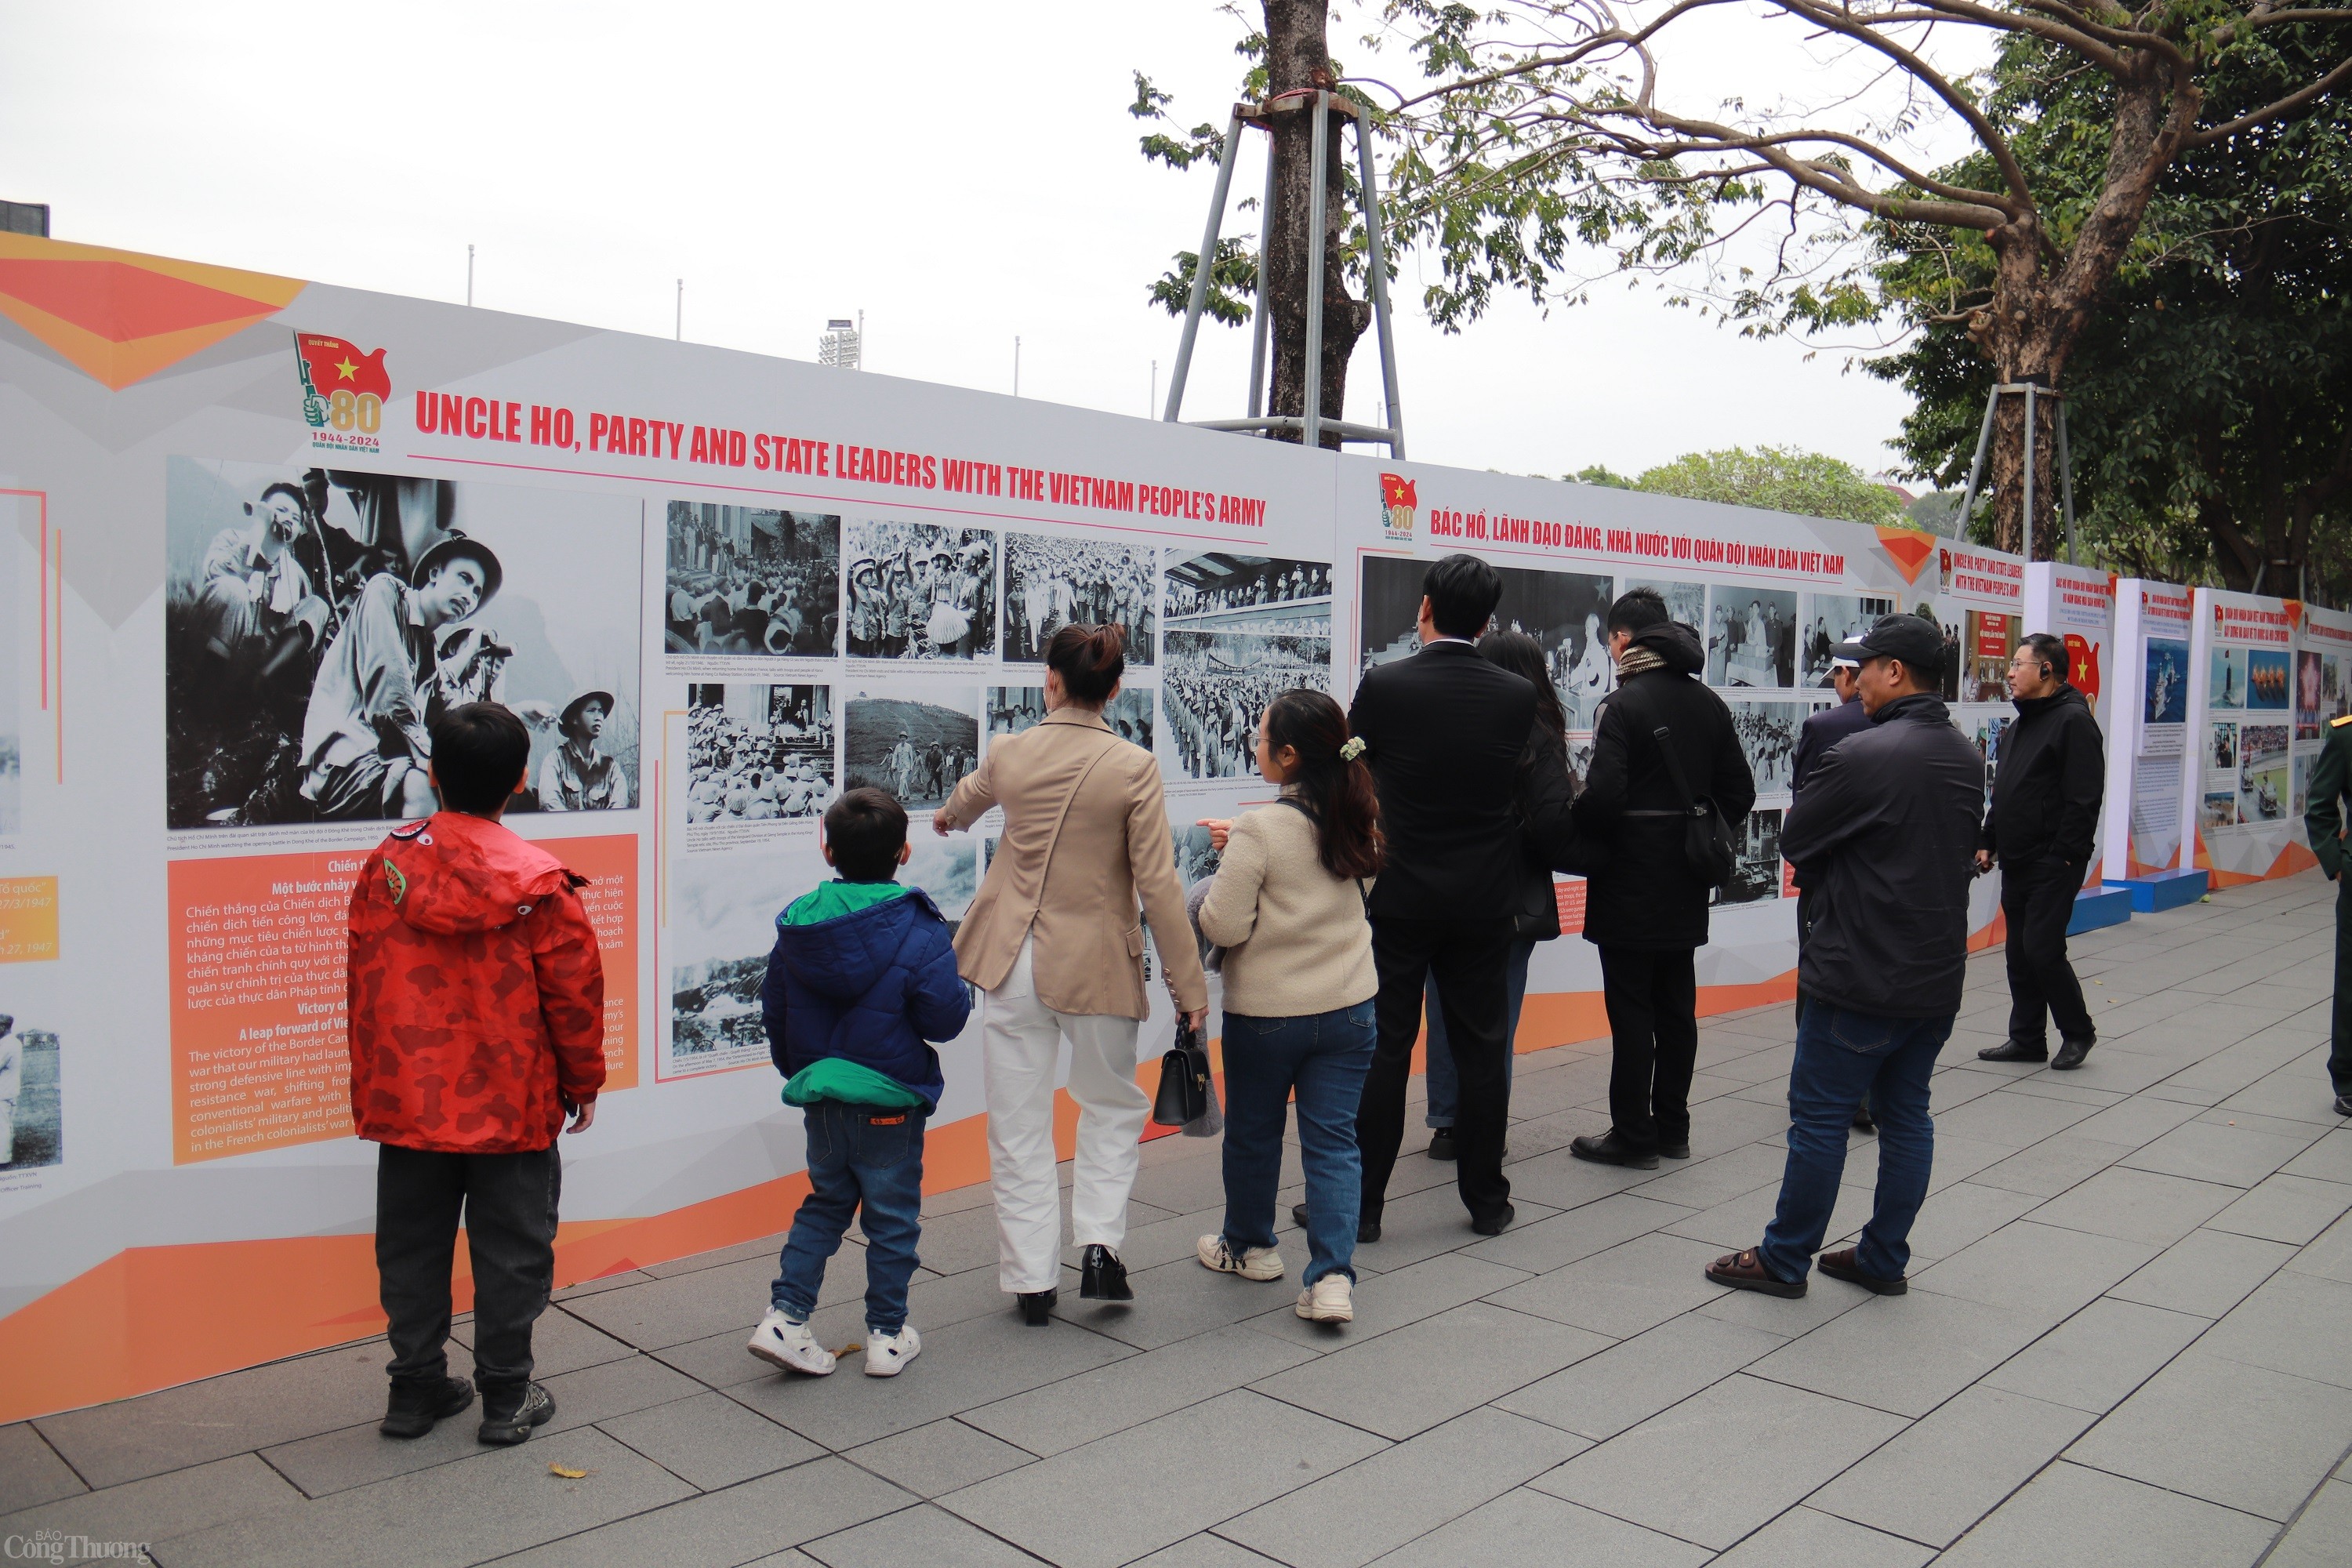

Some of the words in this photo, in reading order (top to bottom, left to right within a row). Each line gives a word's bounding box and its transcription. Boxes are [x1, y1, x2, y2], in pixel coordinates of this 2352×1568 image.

[331, 391, 381, 434] 80
[312, 432, 379, 447] 1944-2024
[416, 391, 521, 442] UNCLE
[530, 405, 581, 454] HO,
[590, 412, 685, 460] PARTY
[689, 426, 746, 467] AND
[753, 433, 829, 477] STATE
[836, 445, 936, 490] LEADERS
[942, 458, 1000, 497] WITH
[1007, 466, 1044, 503] THE
[1049, 472, 1133, 512] VIETNAM
[1219, 495, 1266, 528] ARMY
[1392, 505, 1413, 530] 80
[1431, 506, 1461, 536] BÁC
[1466, 508, 1489, 542] HỒ,
[1493, 514, 1529, 543] LÃNH
[1533, 521, 1561, 549] ĐẠO
[1565, 521, 1603, 553] ĐẢNG,
[1606, 527, 1632, 554] NHÀ
[1636, 531, 1668, 557] NƯỚC
[1671, 534, 1691, 559] VỚI
[1694, 539, 1723, 563] QUÂN
[1726, 541, 1744, 568] ĐỘI
[1748, 544, 1775, 568] NHÂN
[1778, 548, 1797, 570] DÂN
[1801, 550, 1820, 575] VIỆT
[1824, 556, 1843, 575] NAM
[328, 859, 357, 873] Chiến
[272, 883, 292, 897] Một
[296, 880, 321, 895] bước
[324, 880, 349, 893] nhảy
[606, 875, 623, 885] một
[582, 890, 601, 901] thực
[605, 888, 623, 898] hiện
[187, 905, 219, 918] Chiến
[223, 902, 256, 915] thắng
[260, 901, 279, 913] của
[284, 898, 314, 909] Chiến
[318, 896, 340, 908] dịch
[604, 901, 623, 912] cuộc
[187, 920, 217, 934] chiến
[223, 918, 247, 931] dịch
[252, 915, 273, 927] tiến
[278, 913, 305, 926] công
[310, 912, 330, 924] lớn,
[592, 914, 604, 924] kết
[607, 915, 623, 925] hợp
[187, 936, 224, 948] những
[230, 935, 253, 946] mục
[258, 931, 278, 942] tiêu
[283, 927, 311, 939] chiến
[316, 926, 338, 937] lược
[597, 926, 623, 938] hoạch
[187, 952, 223, 964] kháng
[227, 947, 256, 960] chiến
[260, 945, 278, 956] của
[282, 945, 292, 954] ta
[295, 942, 306, 953] từ
[310, 941, 332, 952] hình
[187, 967, 219, 979] chiến
[223, 964, 252, 975] tranh
[256, 960, 286, 972] chính
[290, 959, 310, 970] quy
[314, 956, 329, 966] với
[188, 982, 216, 996] quân
[220, 980, 234, 992] sự
[236, 975, 267, 989] chính
[270, 975, 281, 985] trị
[285, 971, 303, 983] của
[306, 970, 329, 982] thực
[188, 998, 212, 1010] lược
[216, 994, 234, 1007] của
[238, 993, 263, 1005] thực
[267, 989, 286, 1000] dân
[290, 986, 317, 998] Pháp
[321, 983, 340, 995] tính
[297, 1002, 335, 1015] Victory
[239, 1029, 247, 1040] A
[249, 1028, 273, 1040] leap
[275, 1020, 318, 1036] forward
[321, 1018, 332, 1030] of
[609, 1024, 623, 1033] our
[189, 1051, 210, 1062] The
[213, 1046, 252, 1059] victory
[255, 1044, 266, 1054] of
[269, 1042, 286, 1051] the
[290, 1037, 324, 1049] Border
[190, 1068, 209, 1077] war
[213, 1064, 236, 1074] that
[238, 1062, 256, 1070] our
[260, 1054, 300, 1067] military
[303, 1051, 322, 1062] had
[190, 1080, 226, 1093] strong
[230, 1072, 282, 1087] defensive
[286, 1068, 305, 1079] line
[309, 1064, 332, 1075] with
[191, 1092, 246, 1107] resistance
[254, 1088, 276, 1098] war,
[285, 1080, 324, 1094] shifting
[191, 1102, 263, 1123] conventional
[271, 1097, 311, 1109] warfare
[318, 1092, 341, 1102] with
[259, 1113, 299, 1126] military
[303, 1109, 322, 1119] and
[191, 1143, 201, 1152] in
[205, 1139, 223, 1150] the
[227, 1131, 263, 1146] French
[330, 1120, 349, 1129] war
